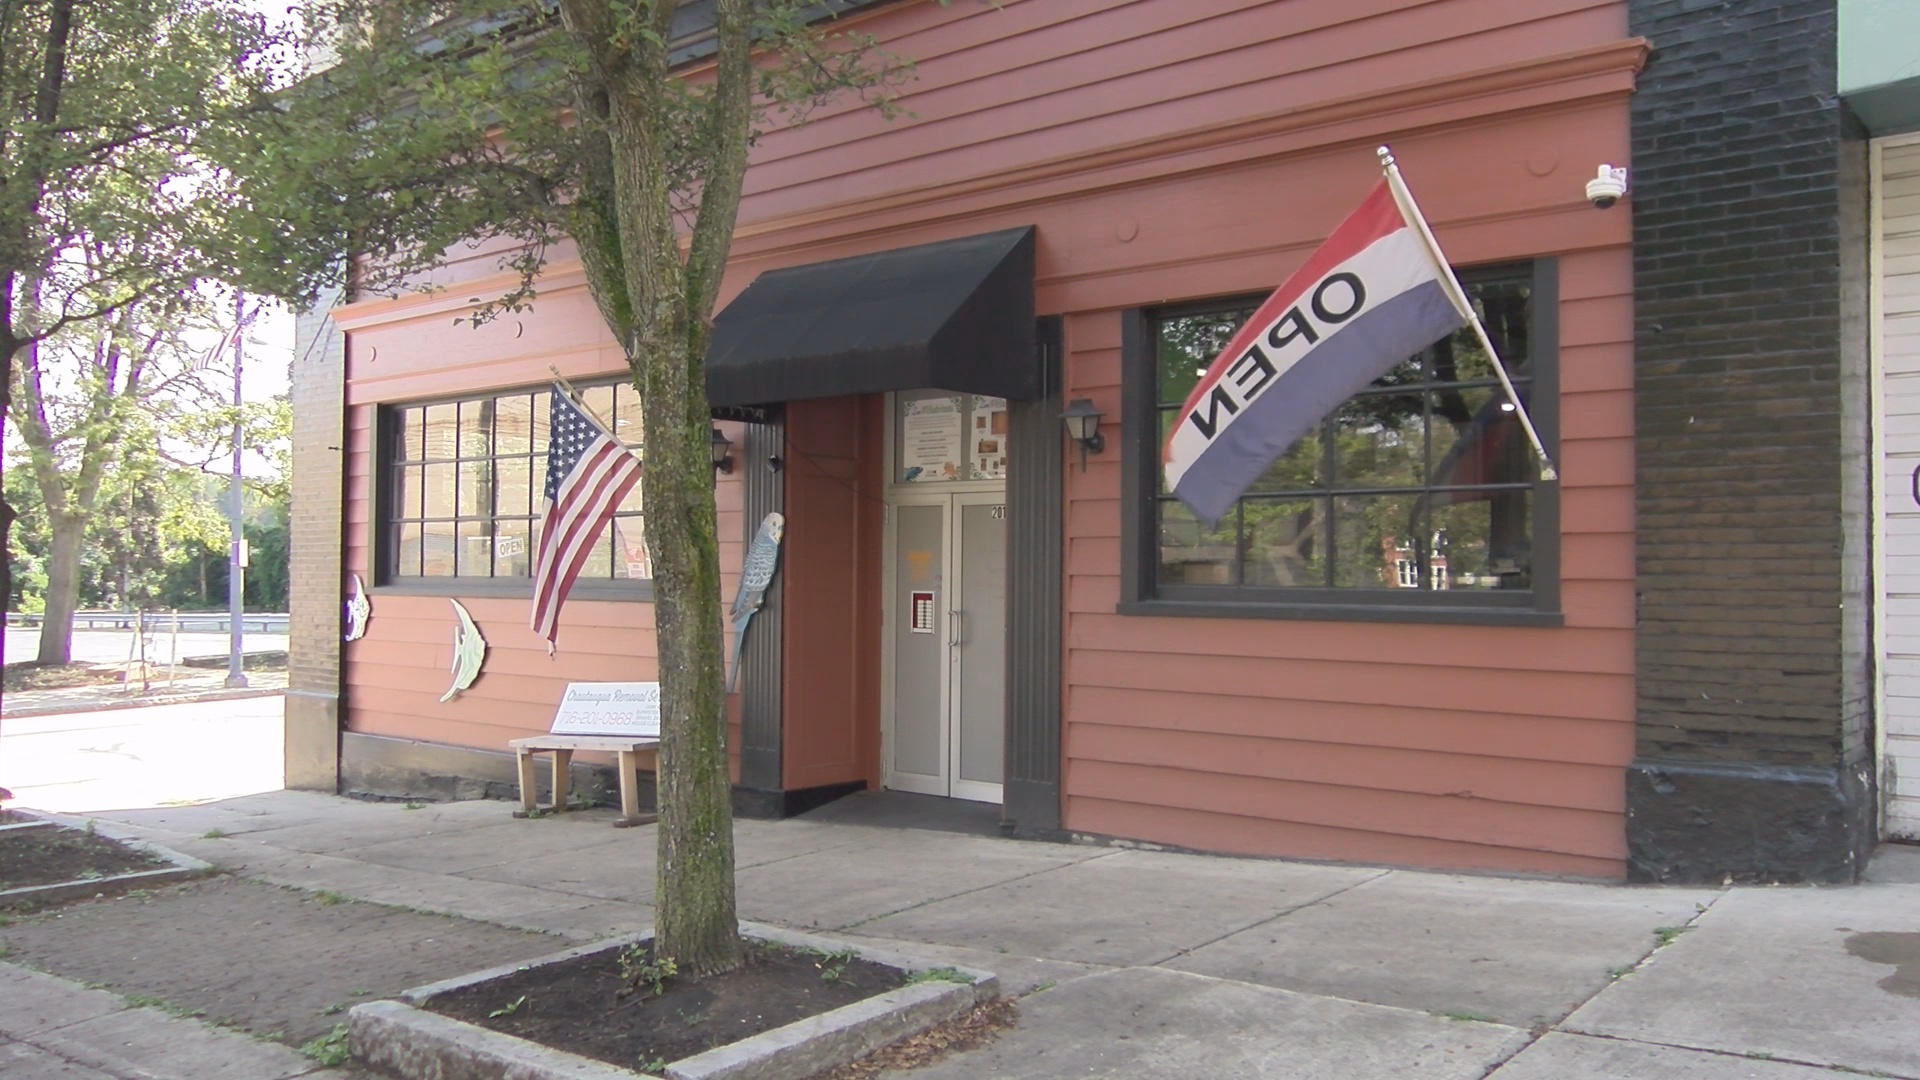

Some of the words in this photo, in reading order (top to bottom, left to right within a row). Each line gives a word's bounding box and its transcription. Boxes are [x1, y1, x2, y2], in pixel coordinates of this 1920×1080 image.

[499, 539, 523, 555] OPEN
[612, 689, 648, 702] Removal
[560, 711, 634, 725] 716-201-0968
